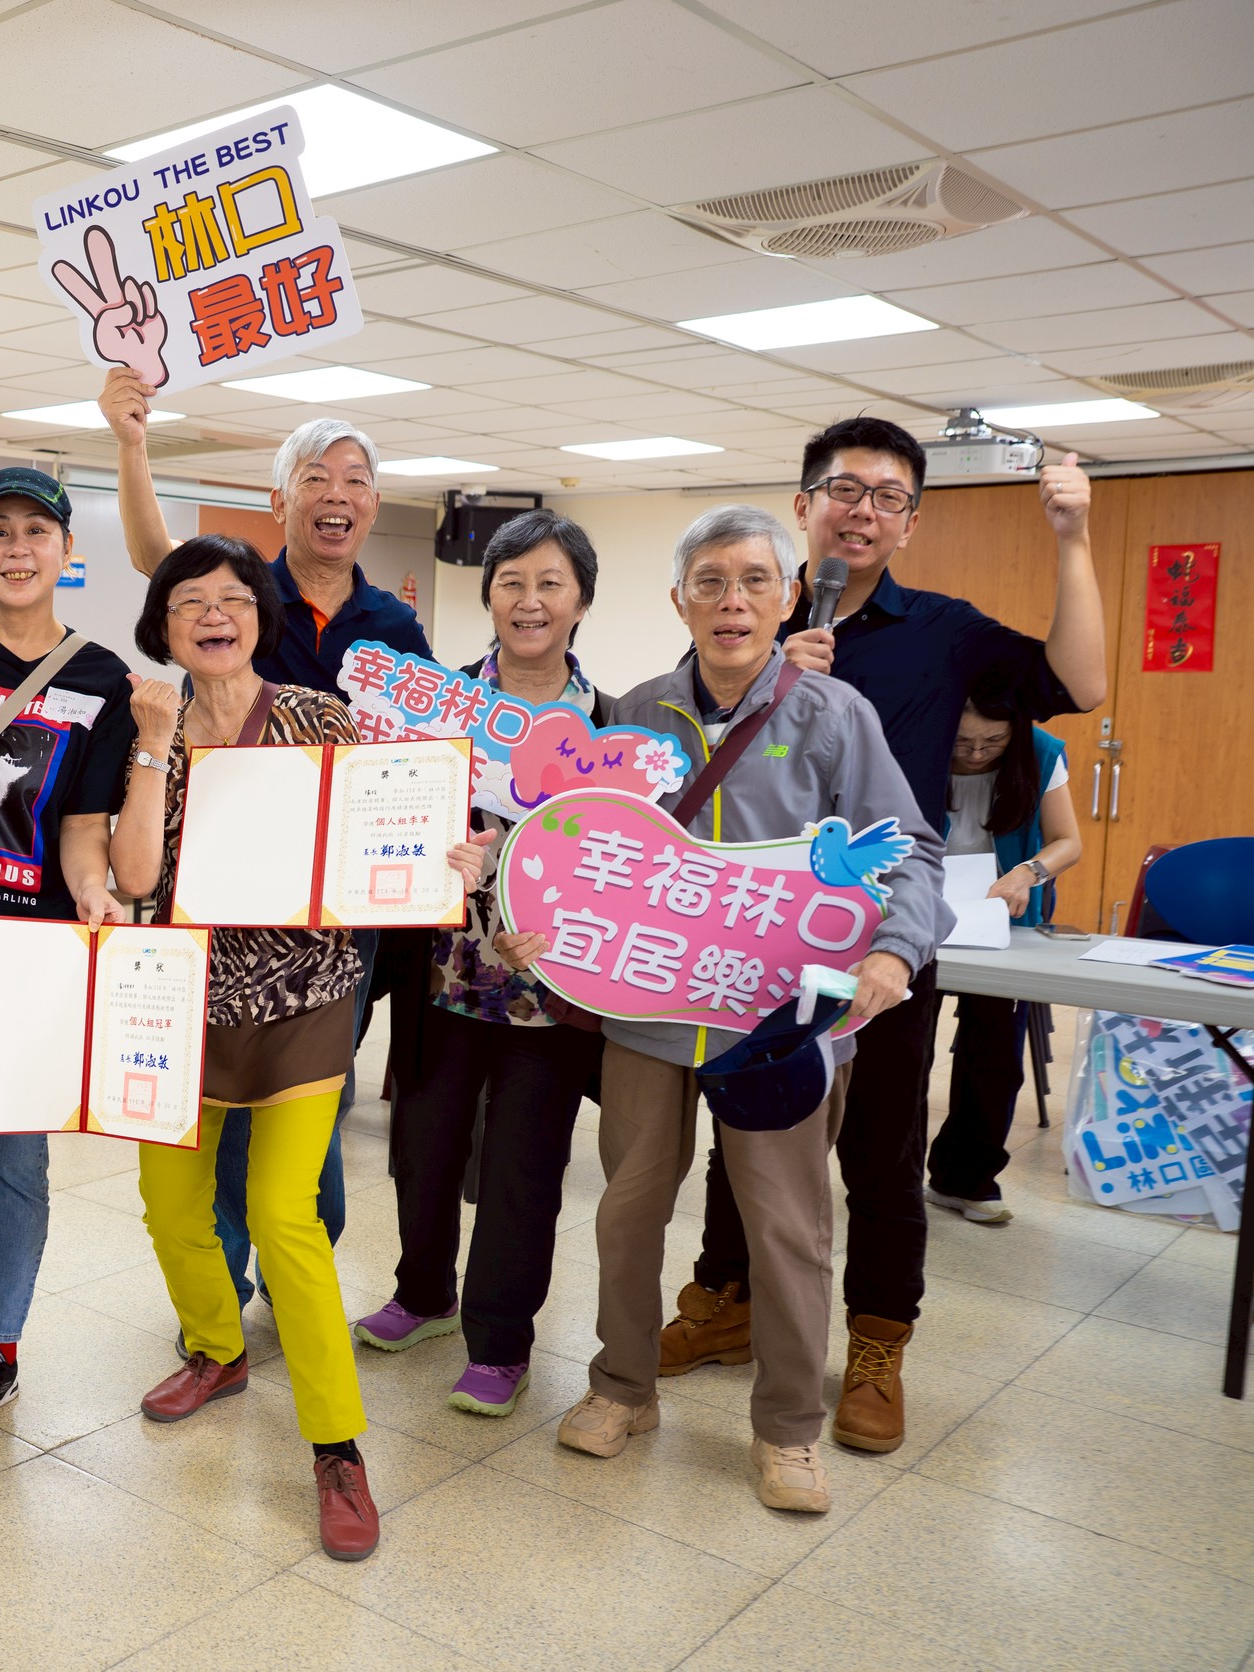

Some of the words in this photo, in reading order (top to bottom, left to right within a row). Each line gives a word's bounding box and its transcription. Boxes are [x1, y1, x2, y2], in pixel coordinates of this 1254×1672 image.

[44, 179, 141, 232] LINKOU
[153, 153, 210, 189] THE
[215, 122, 289, 168] BEST
[142, 165, 304, 283] 林口
[188, 245, 344, 366] 最好
[347, 647, 534, 745] 幸福林口
[574, 829, 867, 953] 幸福林口
